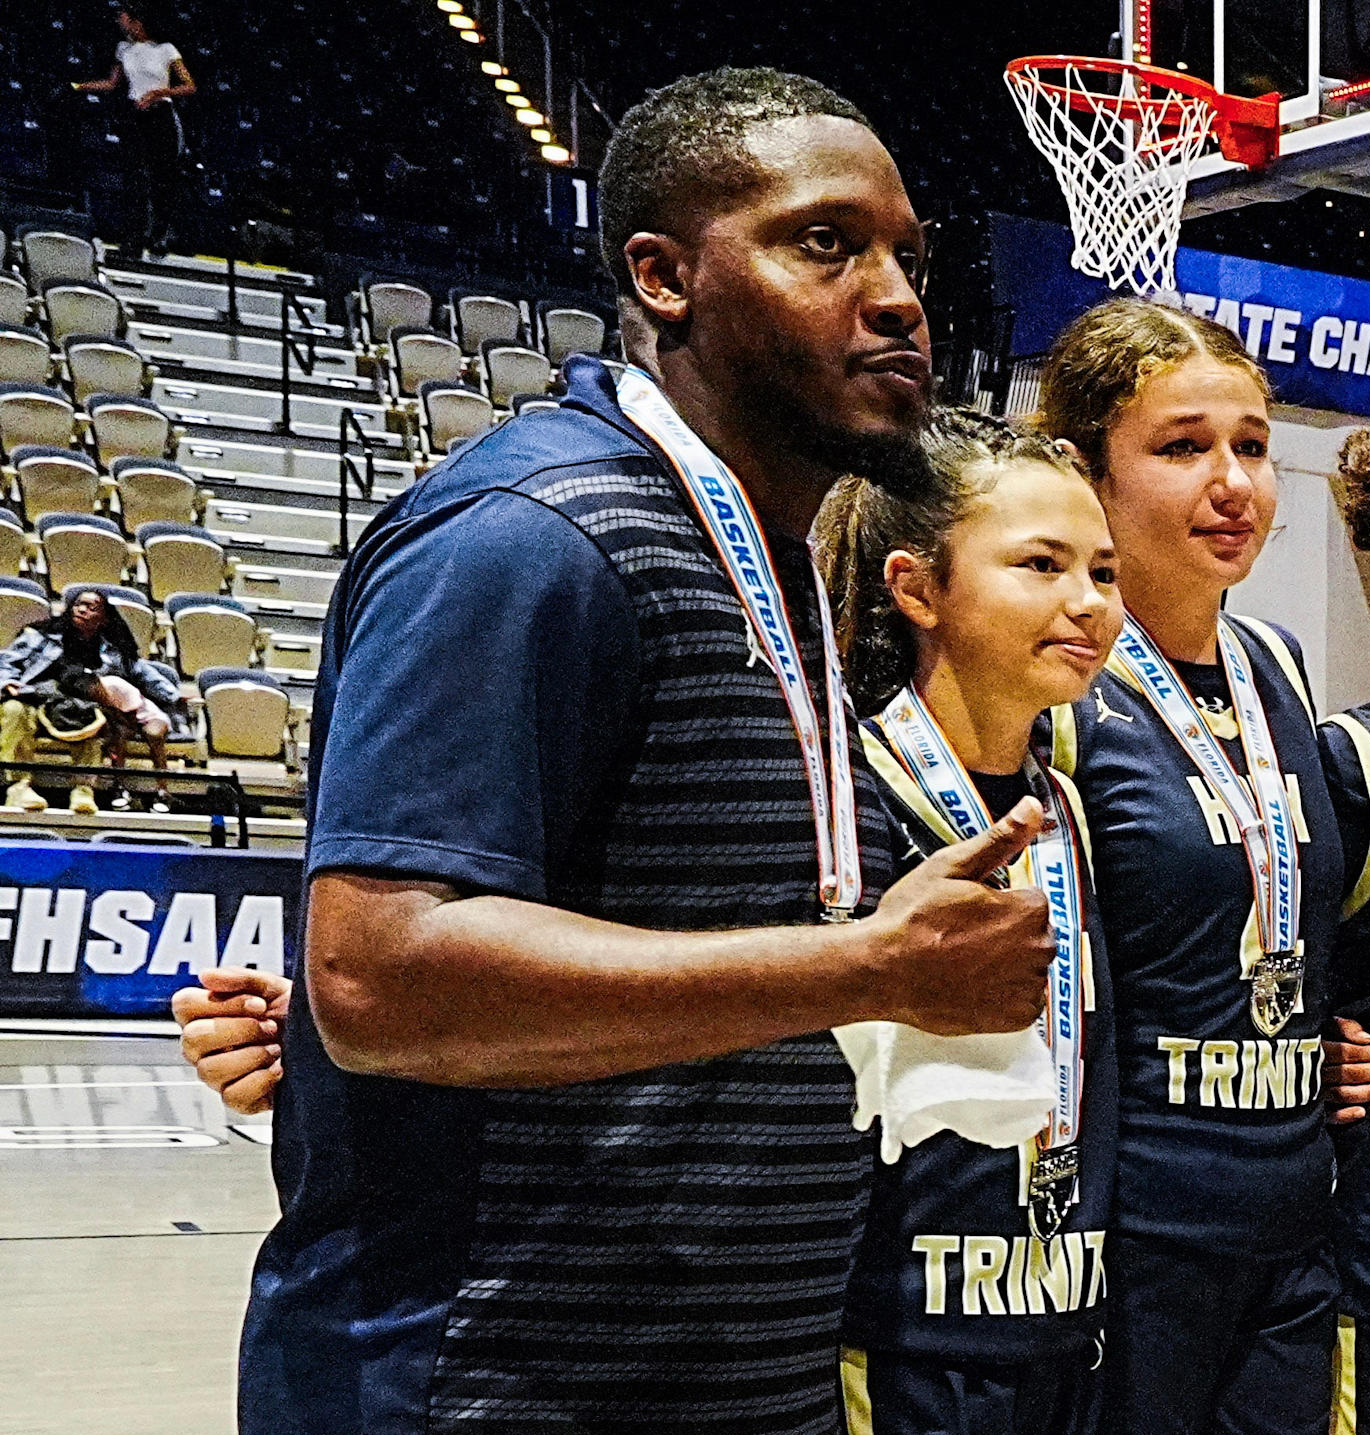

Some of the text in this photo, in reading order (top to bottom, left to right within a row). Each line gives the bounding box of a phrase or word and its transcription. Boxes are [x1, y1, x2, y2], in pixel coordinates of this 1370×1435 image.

[1182, 293, 1302, 364] TATE
[698, 474, 798, 688] BASKETBALL
[909, 724, 940, 769] FLORIDA
[1196, 741, 1230, 785] FLORIDA
[1269, 799, 1290, 953] BASKETBALL
[1046, 860, 1072, 1040] BASKETBALL
[1060, 1063, 1070, 1117] FLORIDA
[1157, 1033, 1324, 1110] TRINIT
